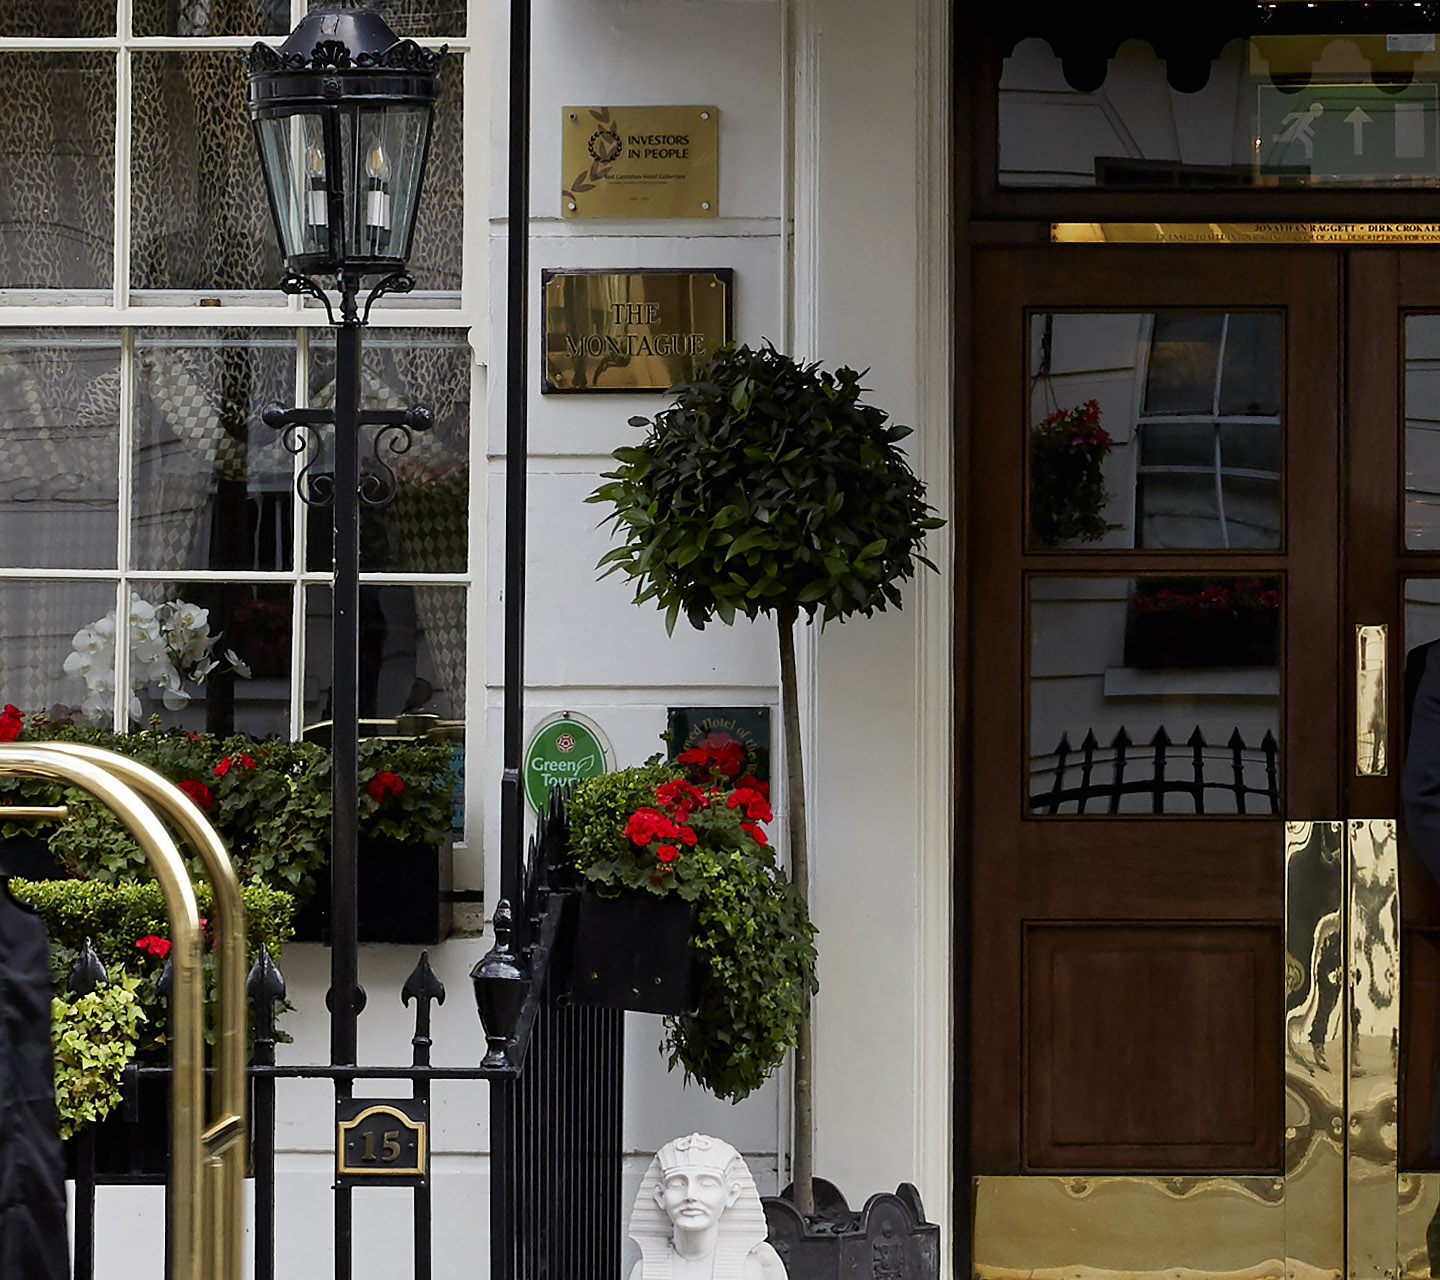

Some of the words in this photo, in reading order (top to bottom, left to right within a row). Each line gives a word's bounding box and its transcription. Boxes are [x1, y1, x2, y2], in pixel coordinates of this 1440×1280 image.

[627, 135, 690, 146] INVESTORS
[627, 149, 641, 159] IN
[643, 148, 689, 160] PEOPLE
[1255, 224, 1307, 232] JONATHAN
[1309, 224, 1355, 232] RAGGETT
[1368, 224, 1393, 232] DIRK
[611, 302, 661, 326] THE
[566, 333, 707, 358] MONTAGUE
[702, 718, 737, 730] Hotel
[531, 757, 577, 772] Green
[541, 773, 591, 788] Tour
[361, 1130, 401, 1162] 15
